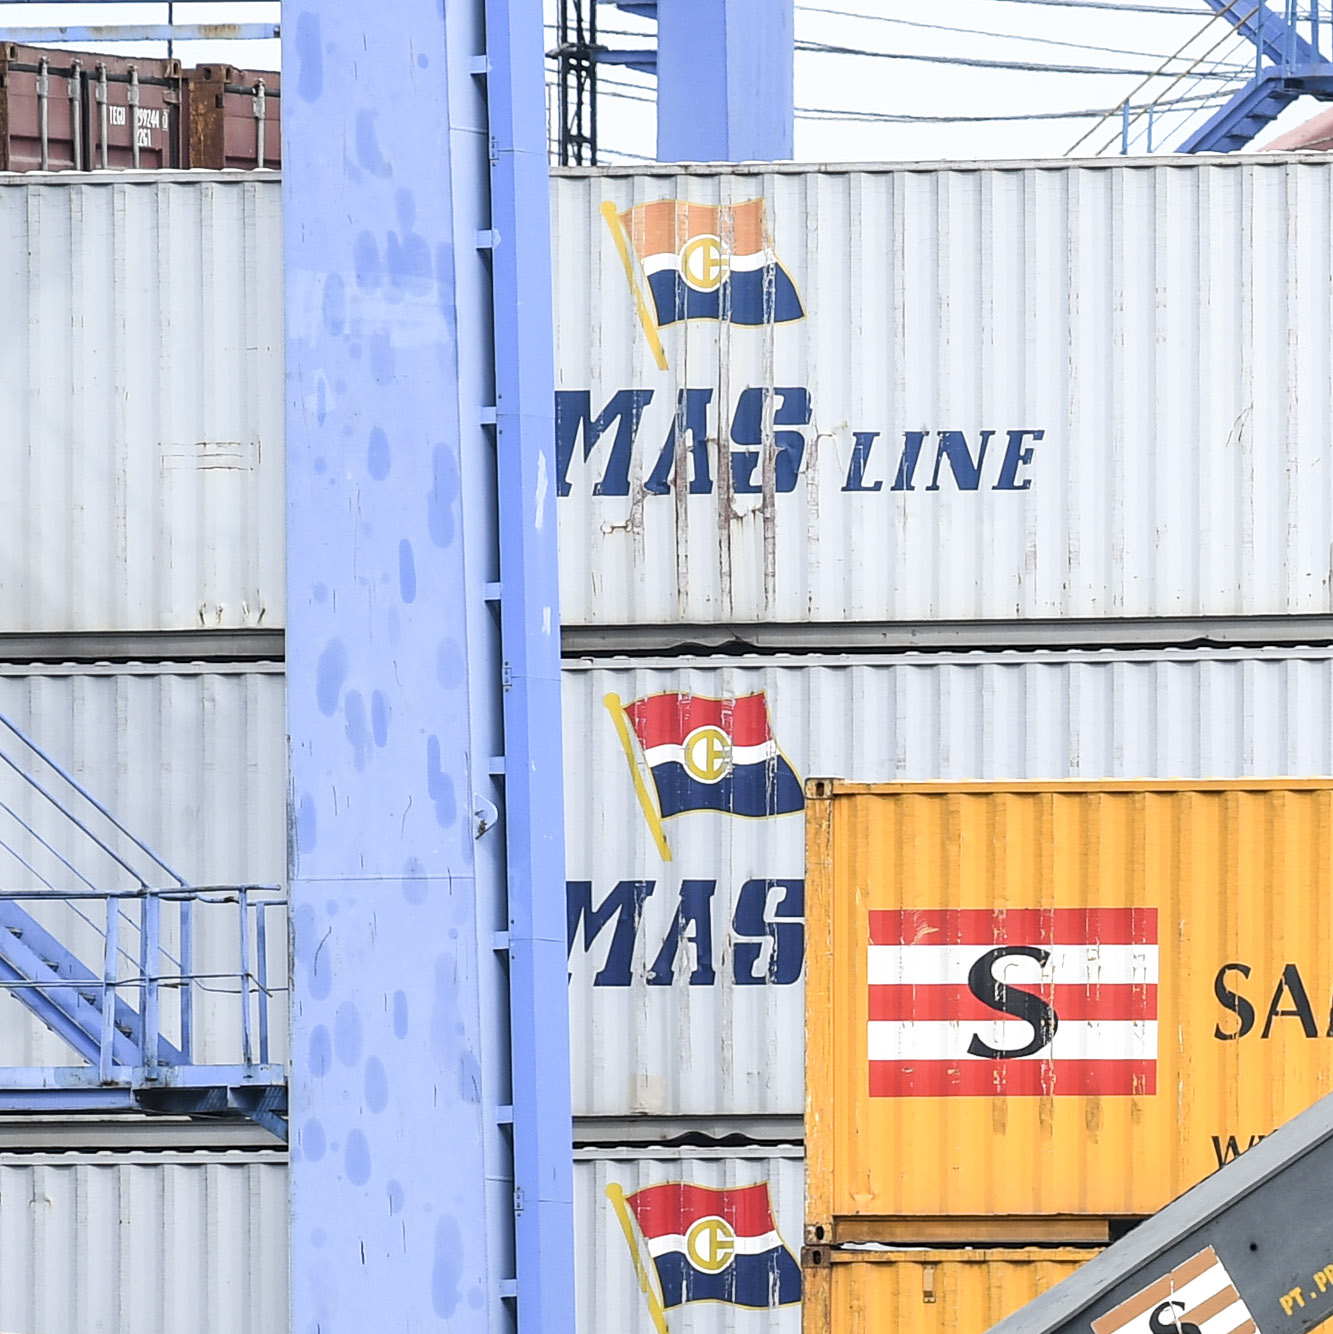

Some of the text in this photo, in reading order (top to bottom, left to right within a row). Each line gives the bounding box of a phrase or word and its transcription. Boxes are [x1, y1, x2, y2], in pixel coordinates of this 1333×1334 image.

[555, 386, 1046, 497] MAS LINE
[566, 879, 805, 987] MAS
[966, 946, 1059, 1060] S
